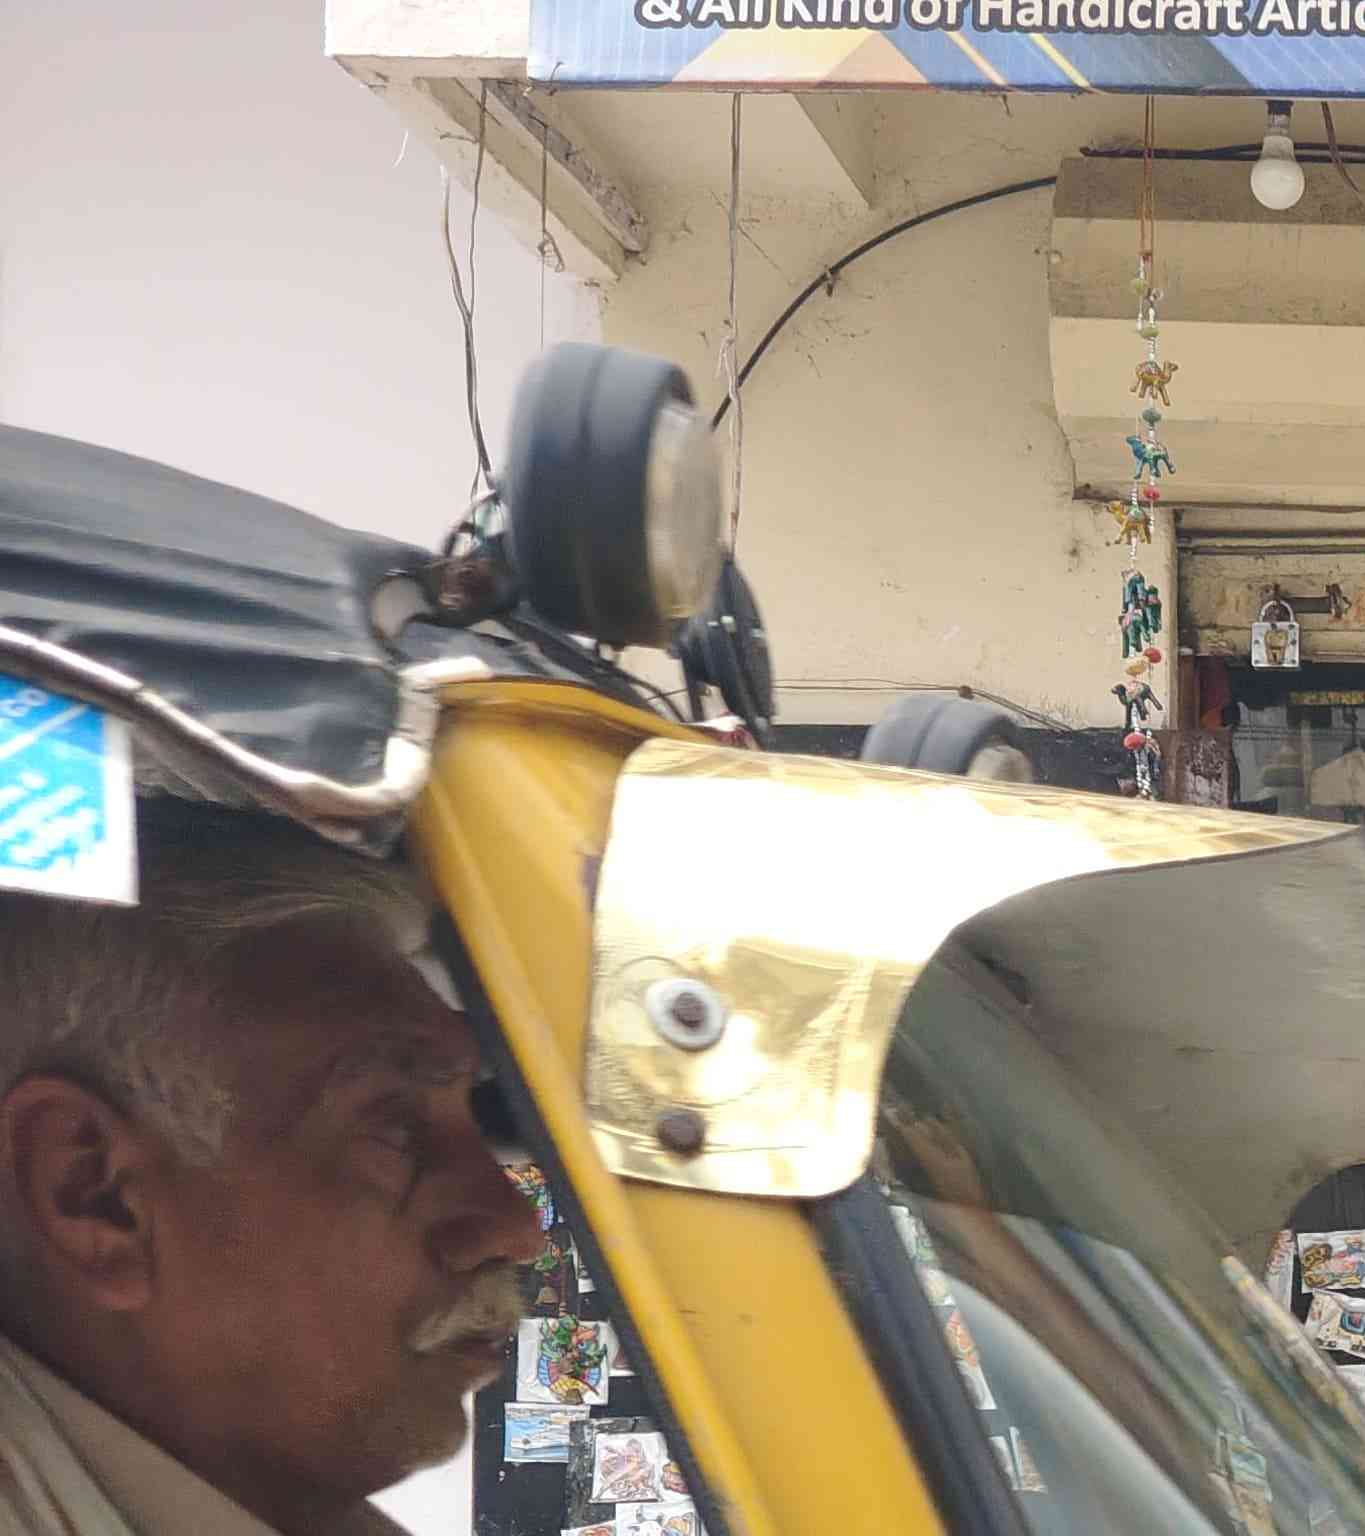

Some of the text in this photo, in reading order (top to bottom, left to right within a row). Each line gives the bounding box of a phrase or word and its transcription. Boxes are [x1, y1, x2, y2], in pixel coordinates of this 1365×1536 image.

[641, 0, 682, 21] &
[699, 0, 765, 22] All
[782, 0, 894, 24] Kind
[909, 0, 962, 25] of
[978, 0, 1243, 29] Handicraft
